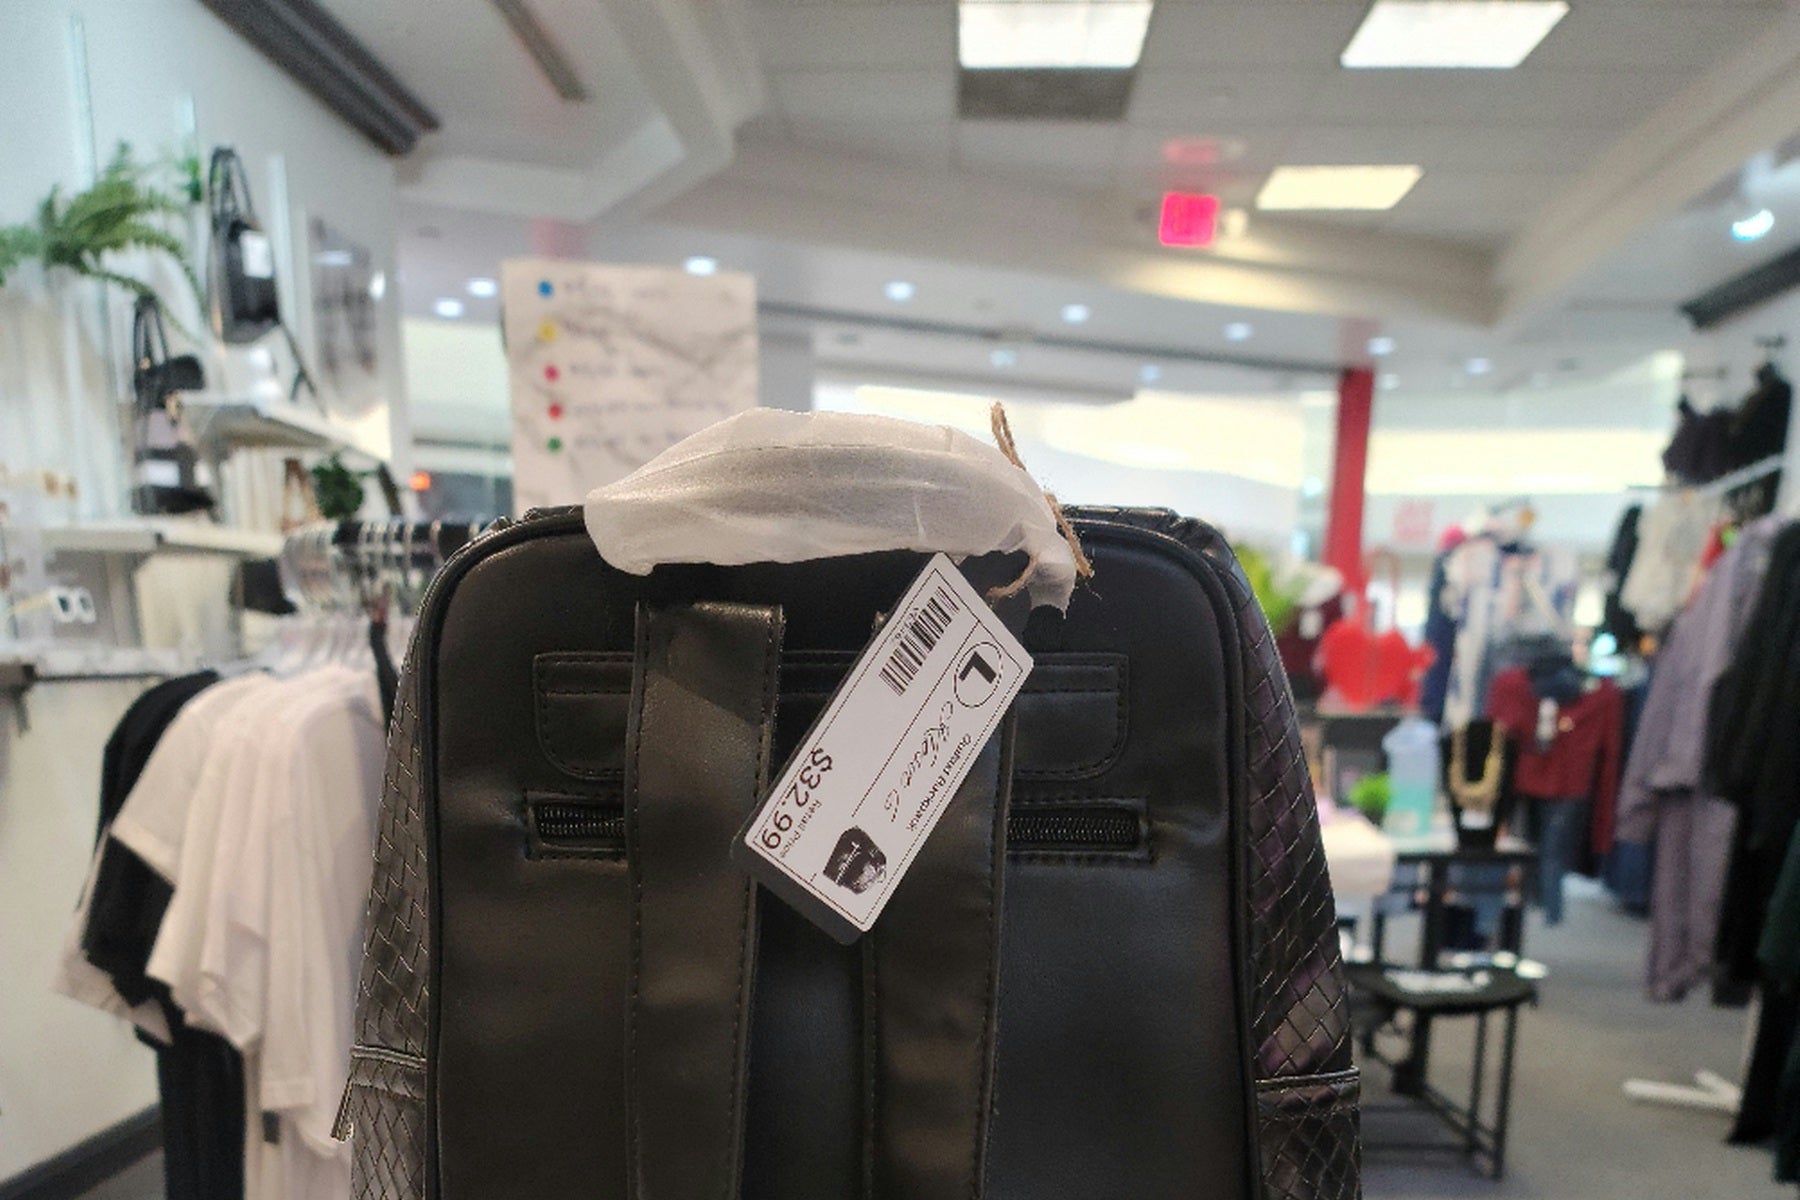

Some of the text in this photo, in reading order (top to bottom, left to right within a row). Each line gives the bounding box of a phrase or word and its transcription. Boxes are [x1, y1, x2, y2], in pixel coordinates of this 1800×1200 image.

[959, 651, 998, 685] L
[761, 747, 834, 850] $32.99
[907, 775, 946, 831] Backpack
[780, 800, 822, 858] Retail Price
